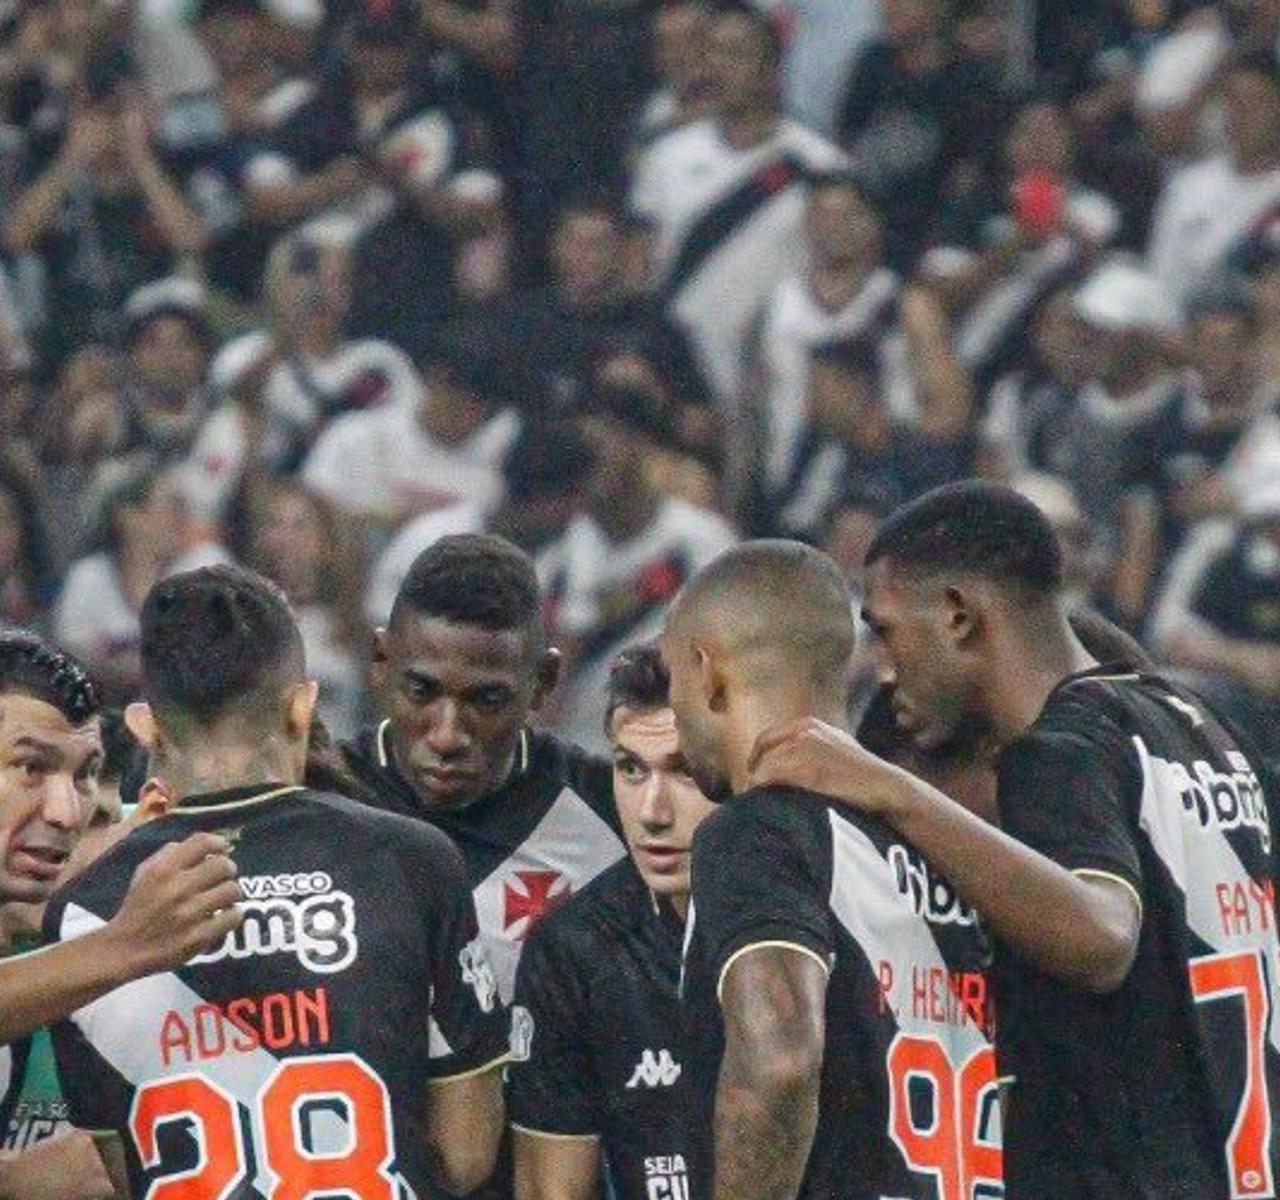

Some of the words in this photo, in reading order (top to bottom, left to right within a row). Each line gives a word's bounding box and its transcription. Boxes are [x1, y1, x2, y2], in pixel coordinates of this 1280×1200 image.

[240, 873, 330, 897] VASCO
[226, 894, 356, 970] mg
[160, 986, 329, 1067] ADSON
